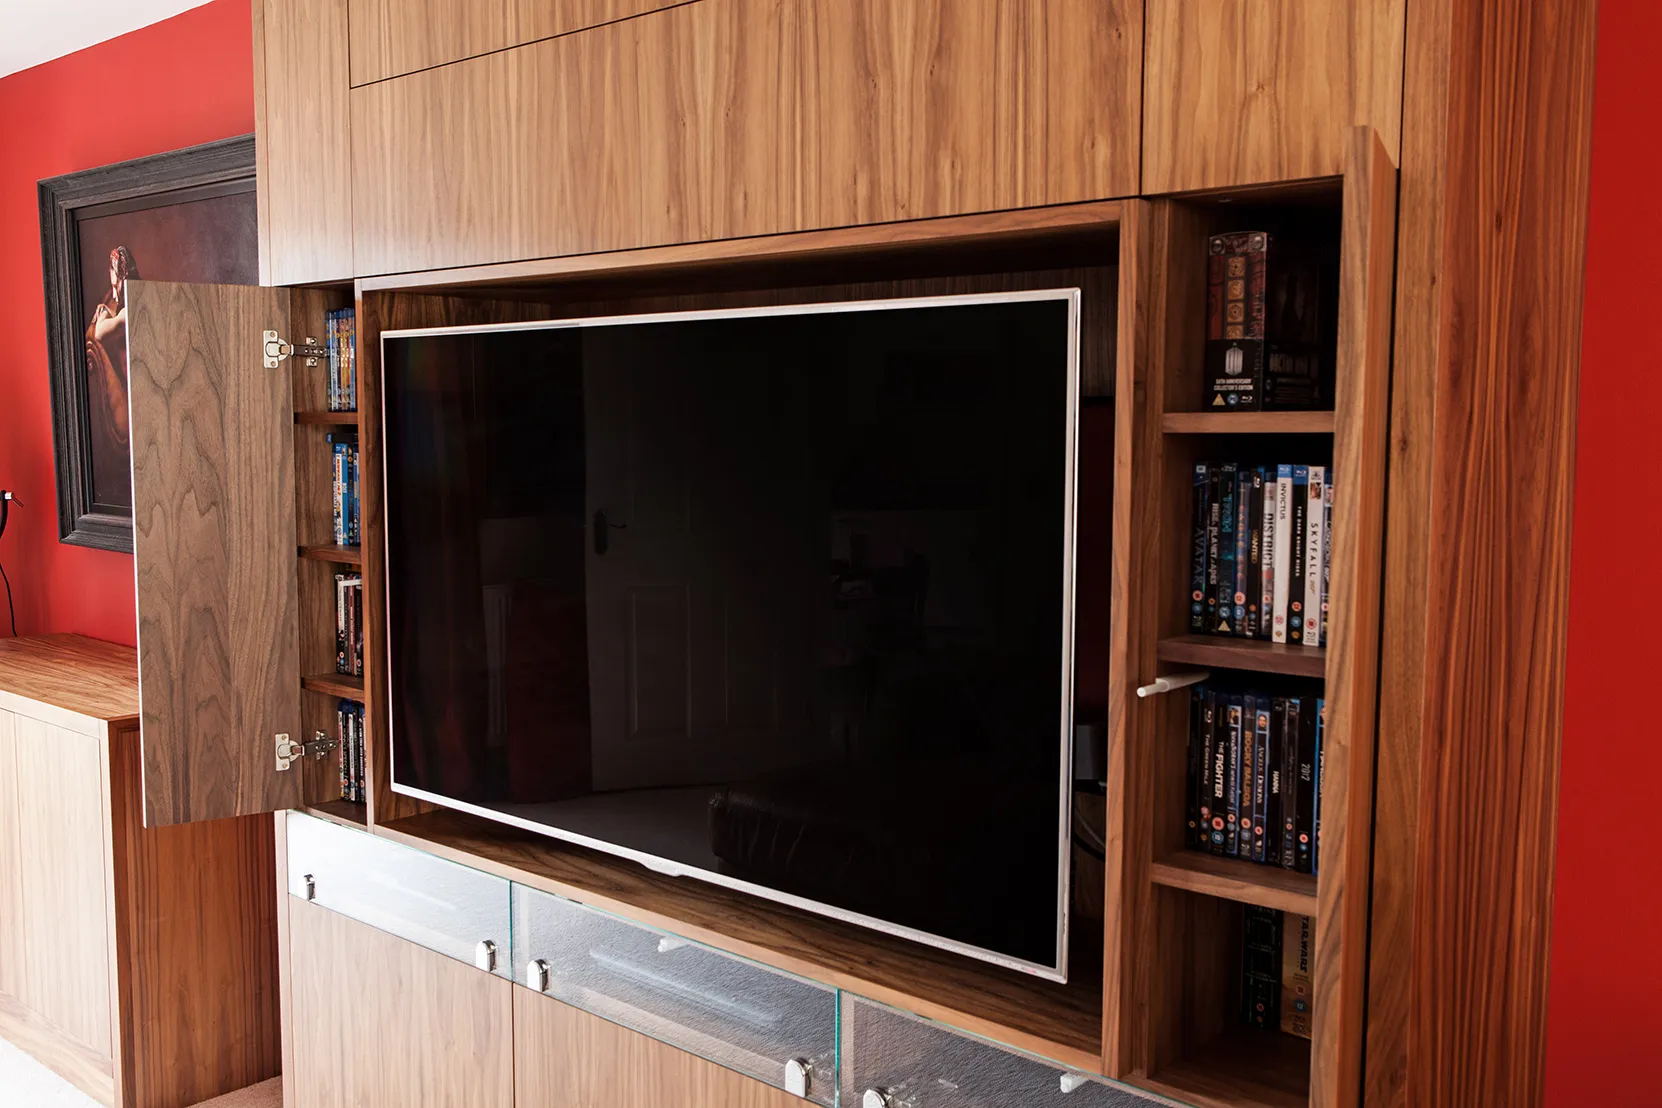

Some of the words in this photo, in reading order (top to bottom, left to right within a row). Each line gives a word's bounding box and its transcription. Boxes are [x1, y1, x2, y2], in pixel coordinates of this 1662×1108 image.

[1192, 526, 1205, 585] AVATAR
[1262, 513, 1274, 568] DISTRICT
[1310, 522, 1319, 577] SKYFALL
[1244, 730, 1252, 766] ROCKY
[1215, 753, 1224, 798] FIGHTER
[1243, 767, 1252, 807] BALBOA
[1300, 763, 1311, 782] 2012
[1300, 941, 1308, 973] WARS
